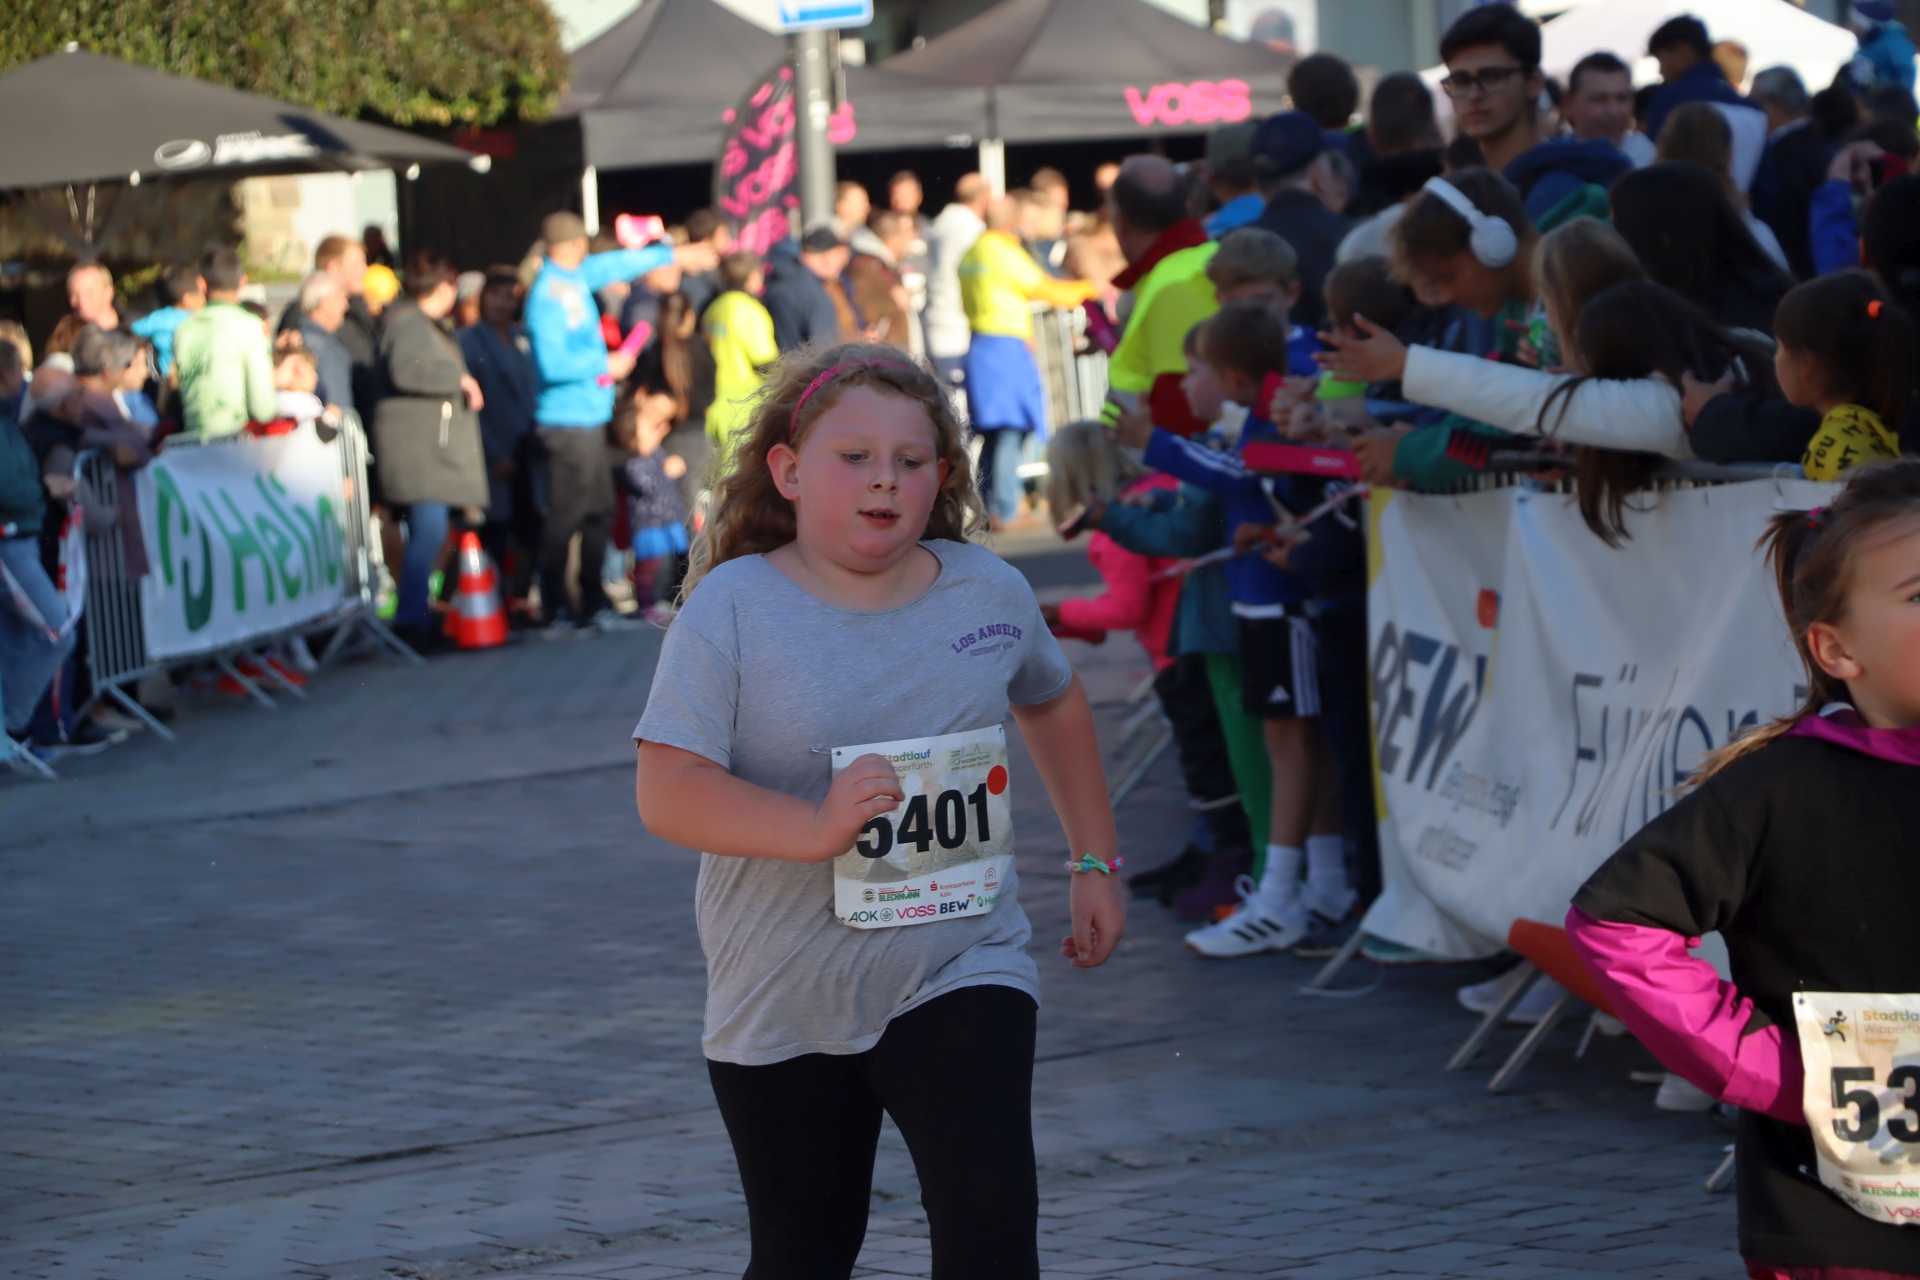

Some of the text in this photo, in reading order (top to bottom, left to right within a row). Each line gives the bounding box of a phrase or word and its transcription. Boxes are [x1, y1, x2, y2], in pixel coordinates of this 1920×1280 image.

[1123, 78, 1252, 127] VOSS
[951, 633, 977, 654] LOS
[978, 623, 1022, 641] ANGELES
[1373, 620, 1487, 792] BEW
[884, 748, 931, 763] tadtlauf
[856, 782, 991, 858] 5401
[878, 891, 920, 902] BLECHMANN
[939, 898, 970, 915] BEW
[848, 910, 879, 923] AOK
[896, 904, 937, 919] VOSS
[1831, 1065, 1920, 1143] 53
